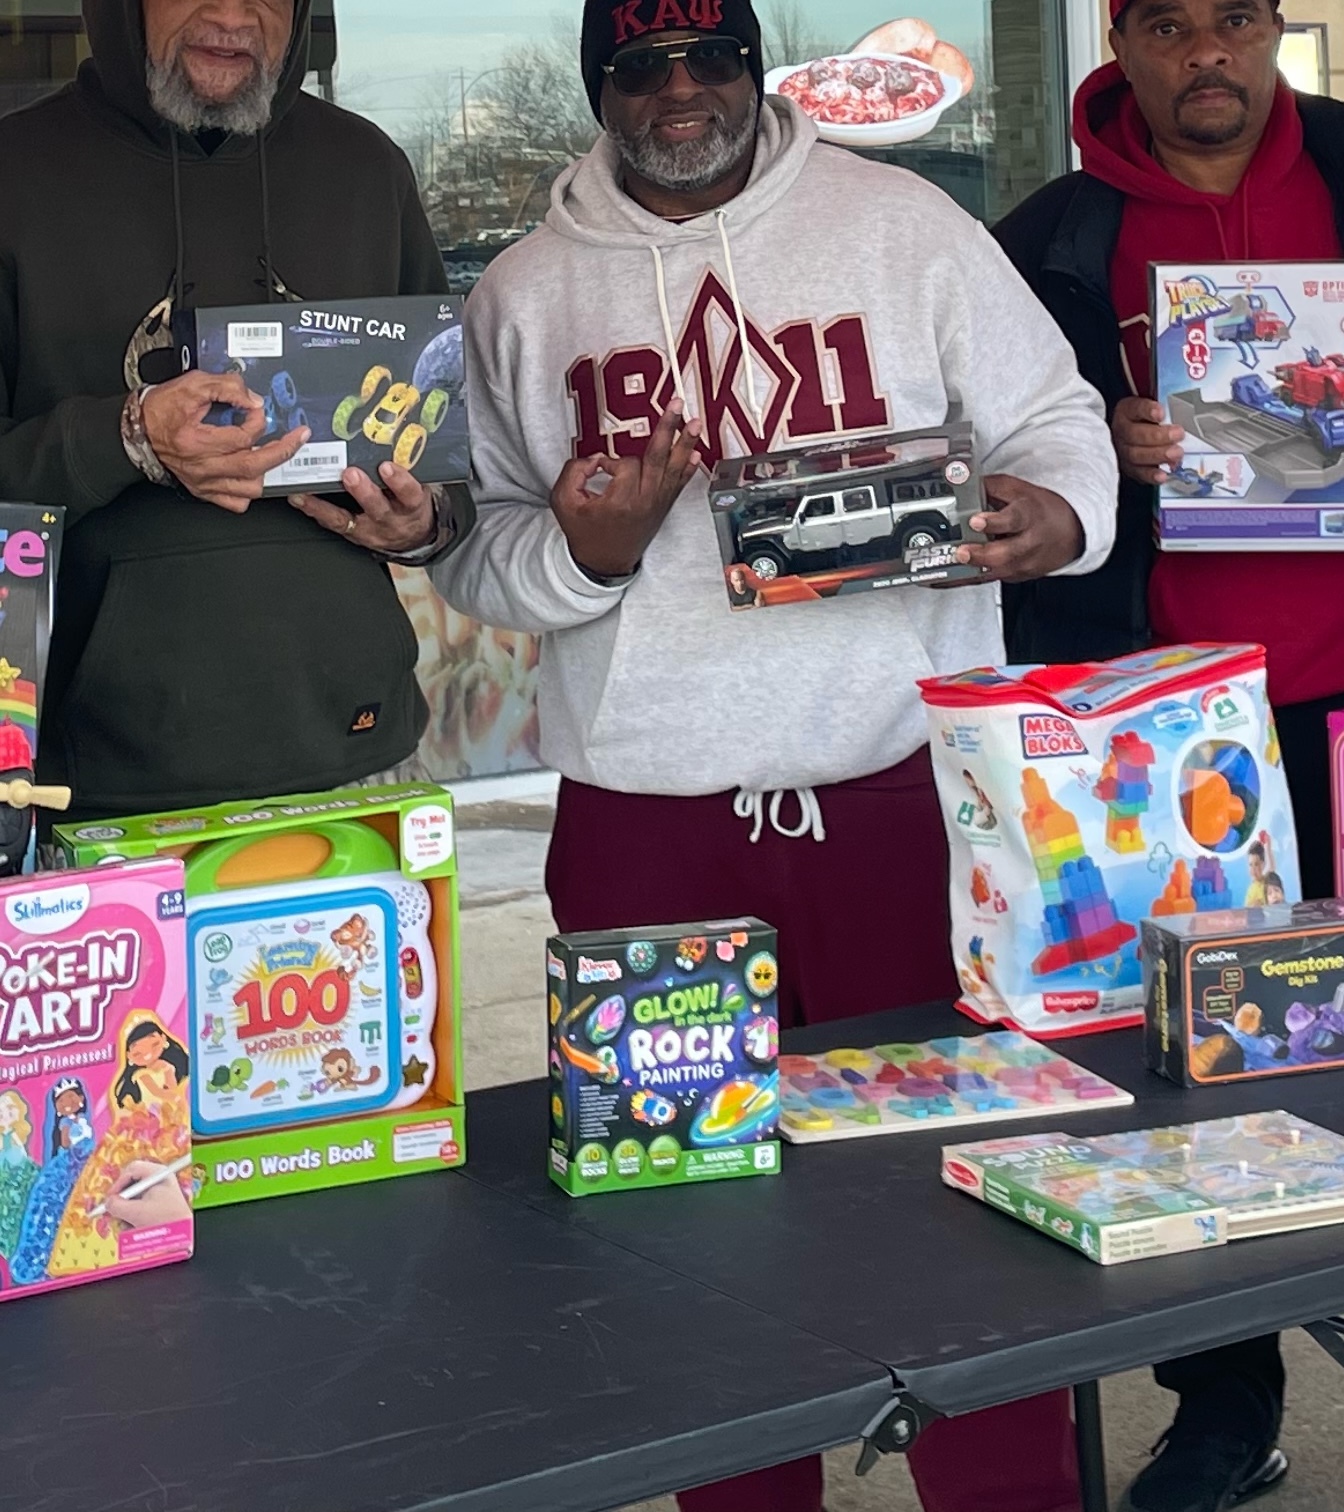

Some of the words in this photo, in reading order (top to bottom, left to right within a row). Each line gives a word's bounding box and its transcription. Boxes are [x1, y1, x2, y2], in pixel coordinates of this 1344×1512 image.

[299, 310, 362, 334] STUNT
[365, 320, 406, 341] CAR
[910, 553, 957, 572] FURI
[1027, 736, 1083, 754] BLOKS
[1288, 975, 1305, 987] Dig
[1306, 973, 1318, 985] Kit
[232, 968, 350, 1040] 100
[633, 982, 719, 1024] GLOW!
[6, 985, 103, 1050] ART
[302, 1029, 343, 1045] BOOK
[628, 1024, 736, 1072] ROCK
[43, 1045, 115, 1073] Princesses!
[639, 1062, 725, 1087] PAINTING
[215, 1159, 253, 1182] 100
[260, 1149, 324, 1176] Words
[327, 1139, 376, 1165] Book
[982, 1144, 1092, 1168] SOUND
